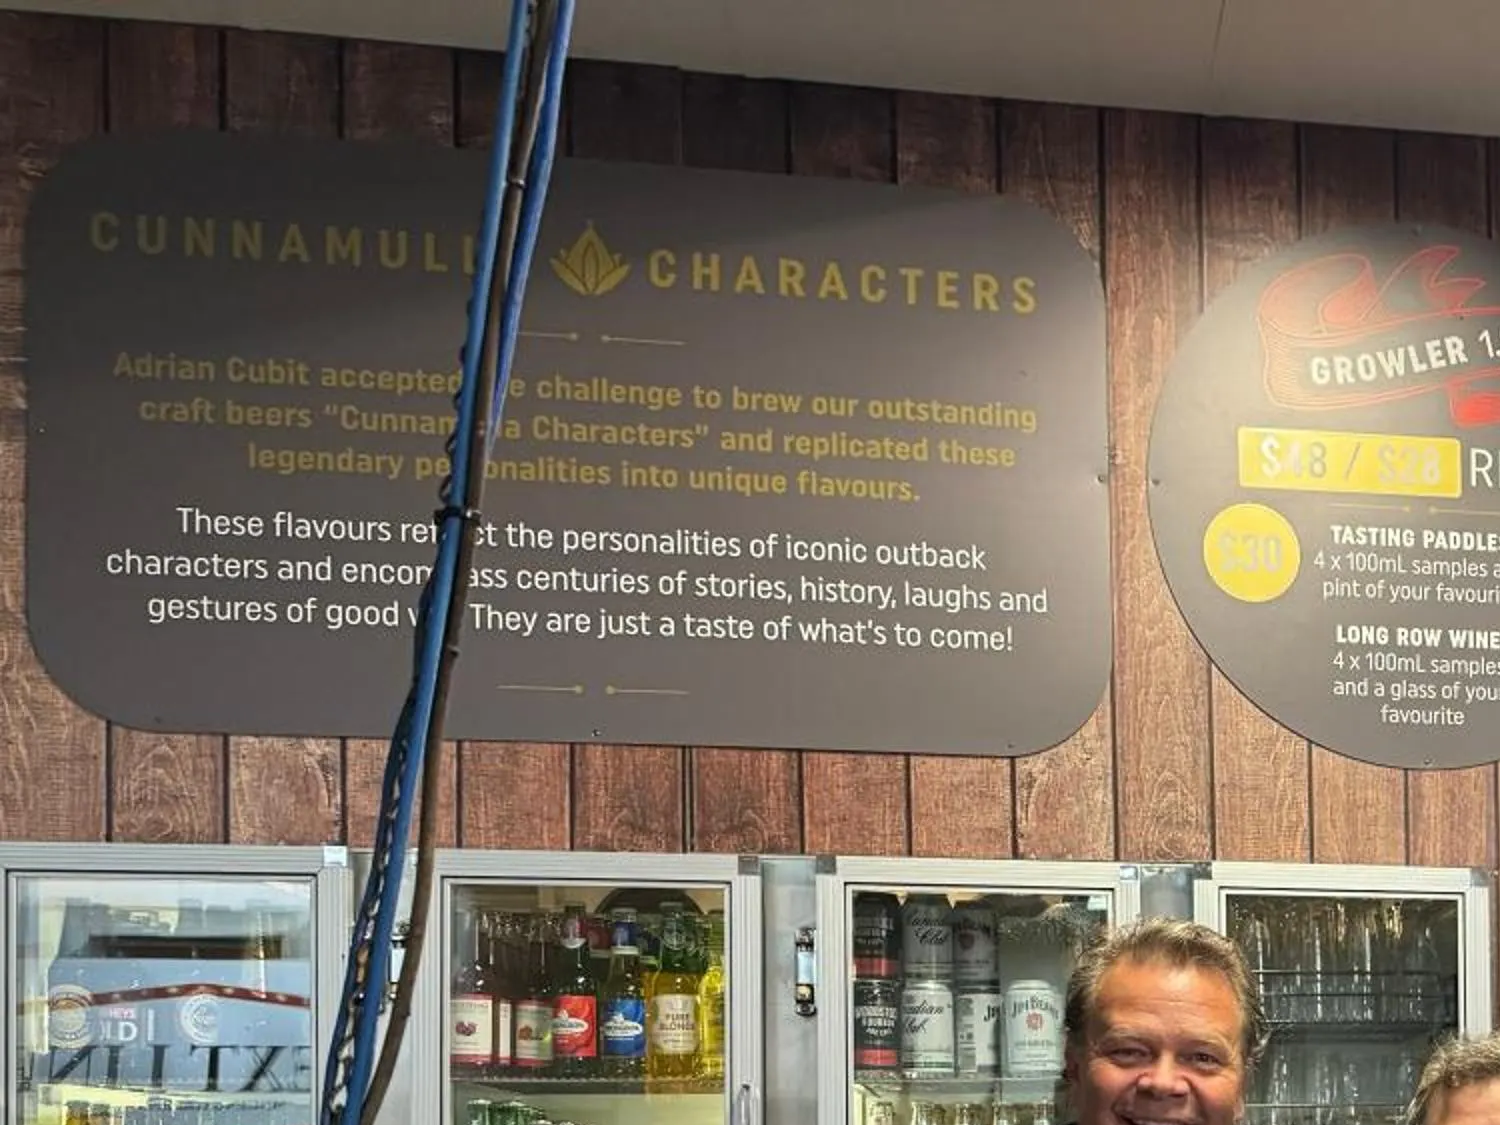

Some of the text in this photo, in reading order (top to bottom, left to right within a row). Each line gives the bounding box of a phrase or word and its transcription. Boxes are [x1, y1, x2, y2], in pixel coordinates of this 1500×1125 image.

[88, 211, 1035, 312] CUNNAMULL CHARACTERS
[1310, 335, 1469, 386] GROWLER
[114, 352, 215, 381] Adrian
[227, 356, 310, 385] Cubit
[321, 366, 463, 397] accepted
[536, 374, 682, 411] challenge
[691, 385, 722, 409] to
[733, 385, 802, 413] brew
[812, 397, 859, 418] our
[868, 398, 1036, 433] outstanding
[140, 397, 215, 423] craft
[227, 400, 312, 428] beers
[324, 404, 521, 439] "Cunnama
[720, 427, 773, 453] and
[783, 431, 928, 461] replicated
[938, 439, 1014, 466] these
[249, 443, 920, 501] legendary peonalities into unique flavours.
[1260, 433, 1327, 479] $48
[1377, 442, 1441, 486] $28
[176, 508, 986, 569] These flavours reft the personalities of iconic outback
[1331, 525, 1416, 549] TASTING
[107, 549, 1046, 613] characters and encomass centuries of stories, history, laughs and
[1314, 551, 1326, 570] 4
[1330, 556, 1342, 571] x
[1346, 553, 1408, 574] 100mL
[1411, 557, 1489, 580] samples
[1323, 578, 1361, 600] pint
[1365, 579, 1388, 599] of
[1389, 582, 1432, 604] your
[148, 596, 277, 623] gestures
[287, 597, 317, 623] of
[326, 600, 398, 629] good
[468, 604, 538, 636] They
[546, 612, 590, 633] are
[597, 608, 651, 638] just
[659, 617, 674, 636] a
[683, 613, 754, 639] taste
[764, 615, 792, 640] of
[798, 618, 886, 645] what's
[894, 623, 921, 646] to
[930, 627, 1011, 650] come!
[1336, 624, 1500, 651] LONG ROW WINE
[1333, 652, 1345, 670] 4
[1349, 656, 1361, 671] x
[1364, 652, 1427, 674] 100mL
[1333, 677, 1369, 698] and
[1374, 682, 1386, 698] a
[1390, 678, 1437, 702] glass
[1441, 679, 1463, 700] of
[1381, 703, 1465, 726] favourite
